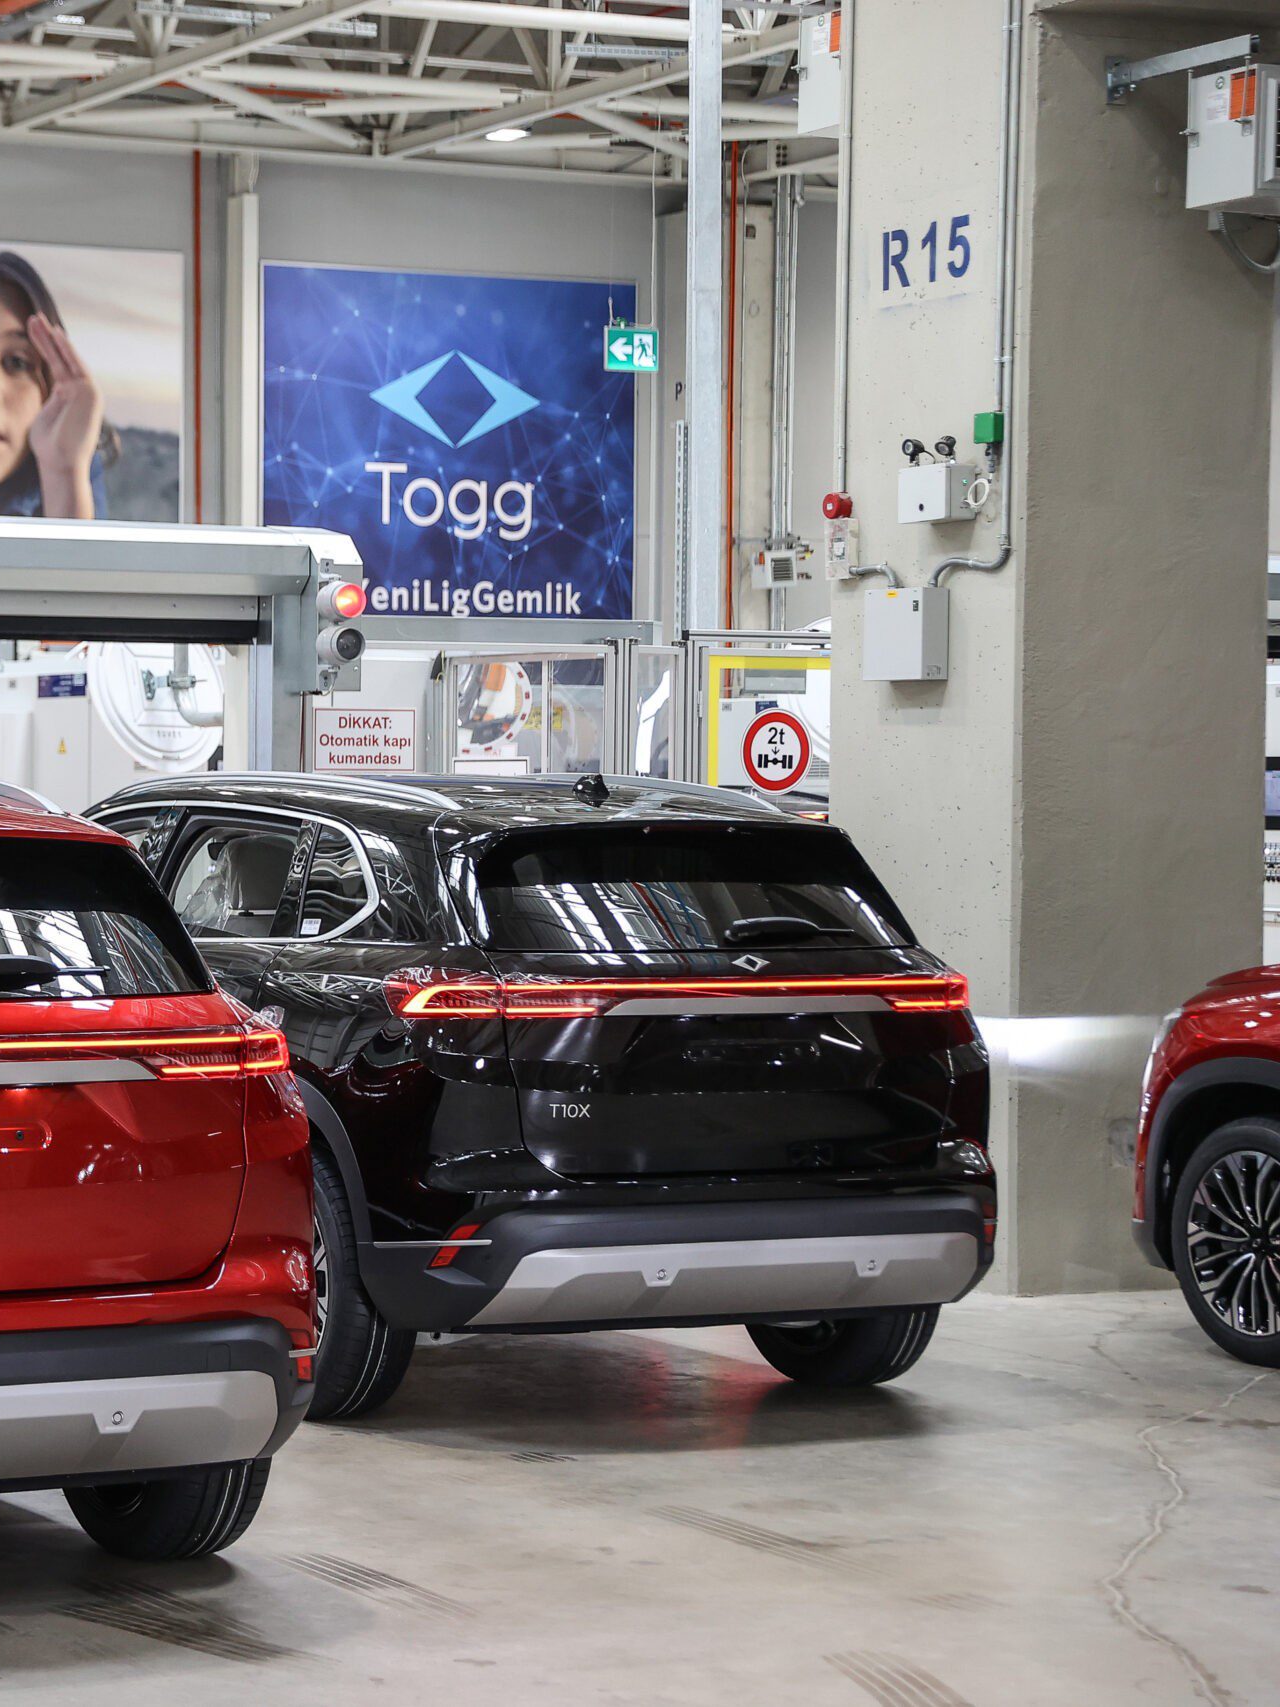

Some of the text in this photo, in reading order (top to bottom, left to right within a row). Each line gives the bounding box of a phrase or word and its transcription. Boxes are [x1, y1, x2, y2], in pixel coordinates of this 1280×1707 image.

[365, 462, 533, 541] Togg
[338, 713, 392, 729] DİKKAT:
[319, 733, 411, 749] Otomatik kapı
[767, 727, 785, 745] 2t
[329, 752, 401, 765] kumandası
[549, 1103, 591, 1118] T10X
